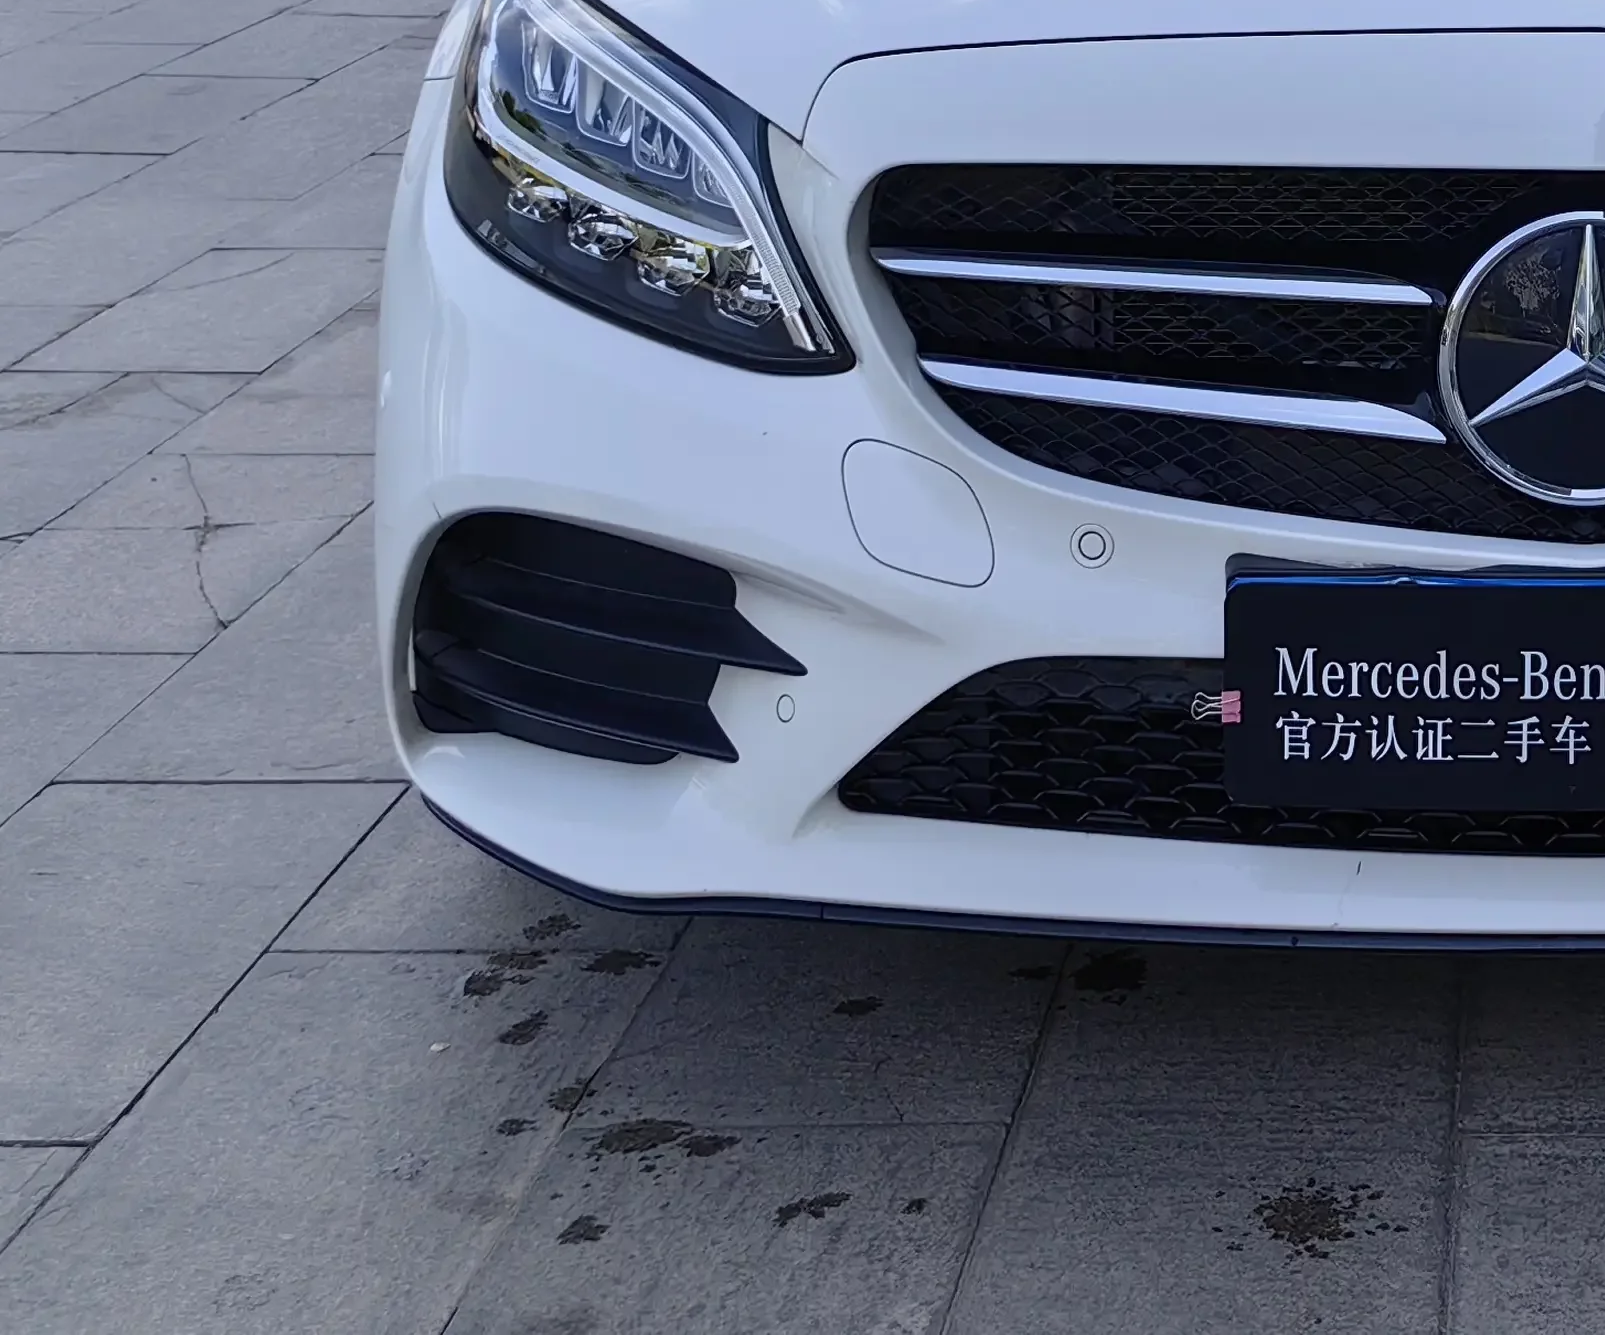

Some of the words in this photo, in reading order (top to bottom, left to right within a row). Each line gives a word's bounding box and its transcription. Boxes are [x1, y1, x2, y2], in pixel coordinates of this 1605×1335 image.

[1275, 711, 1593, 765] 官方认证二手车
